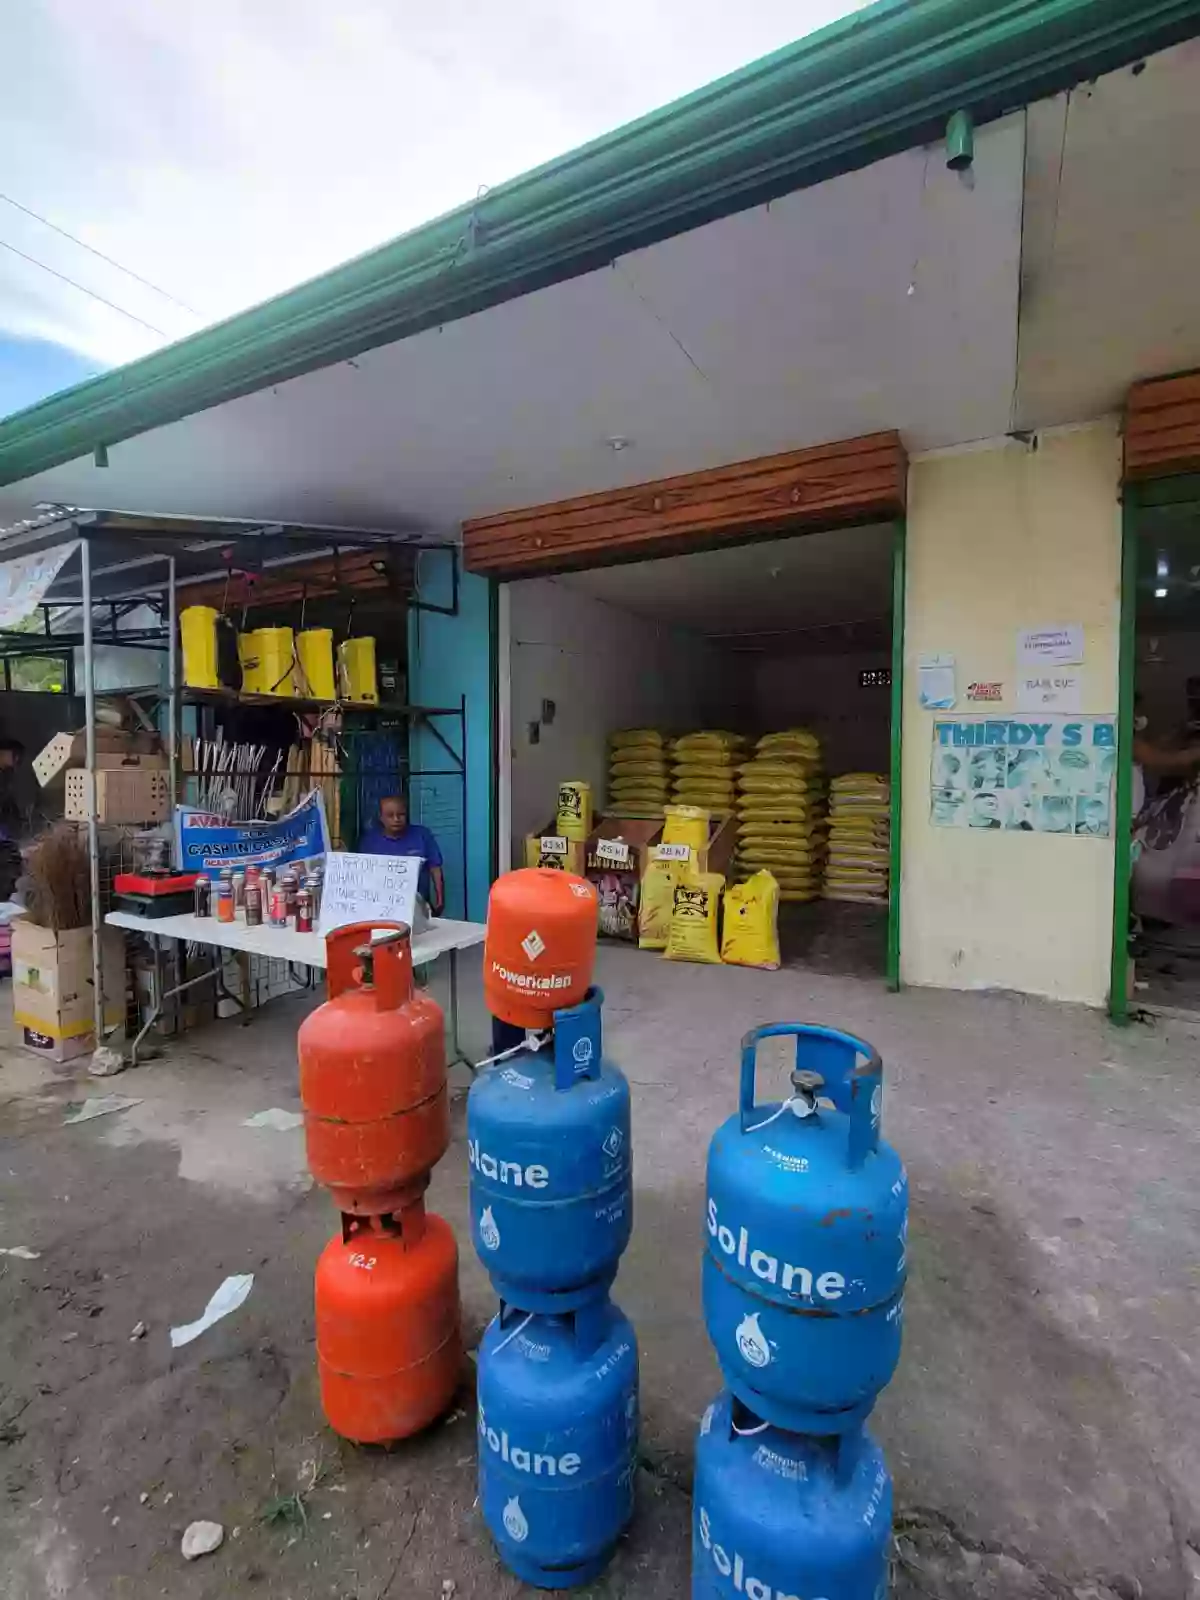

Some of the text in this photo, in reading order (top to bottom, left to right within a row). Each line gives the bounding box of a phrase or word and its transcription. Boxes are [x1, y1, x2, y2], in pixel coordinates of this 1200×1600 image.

[935, 722, 1052, 747] THIRDY
[1062, 723, 1085, 747] S
[707, 1198, 846, 1302] Solane
